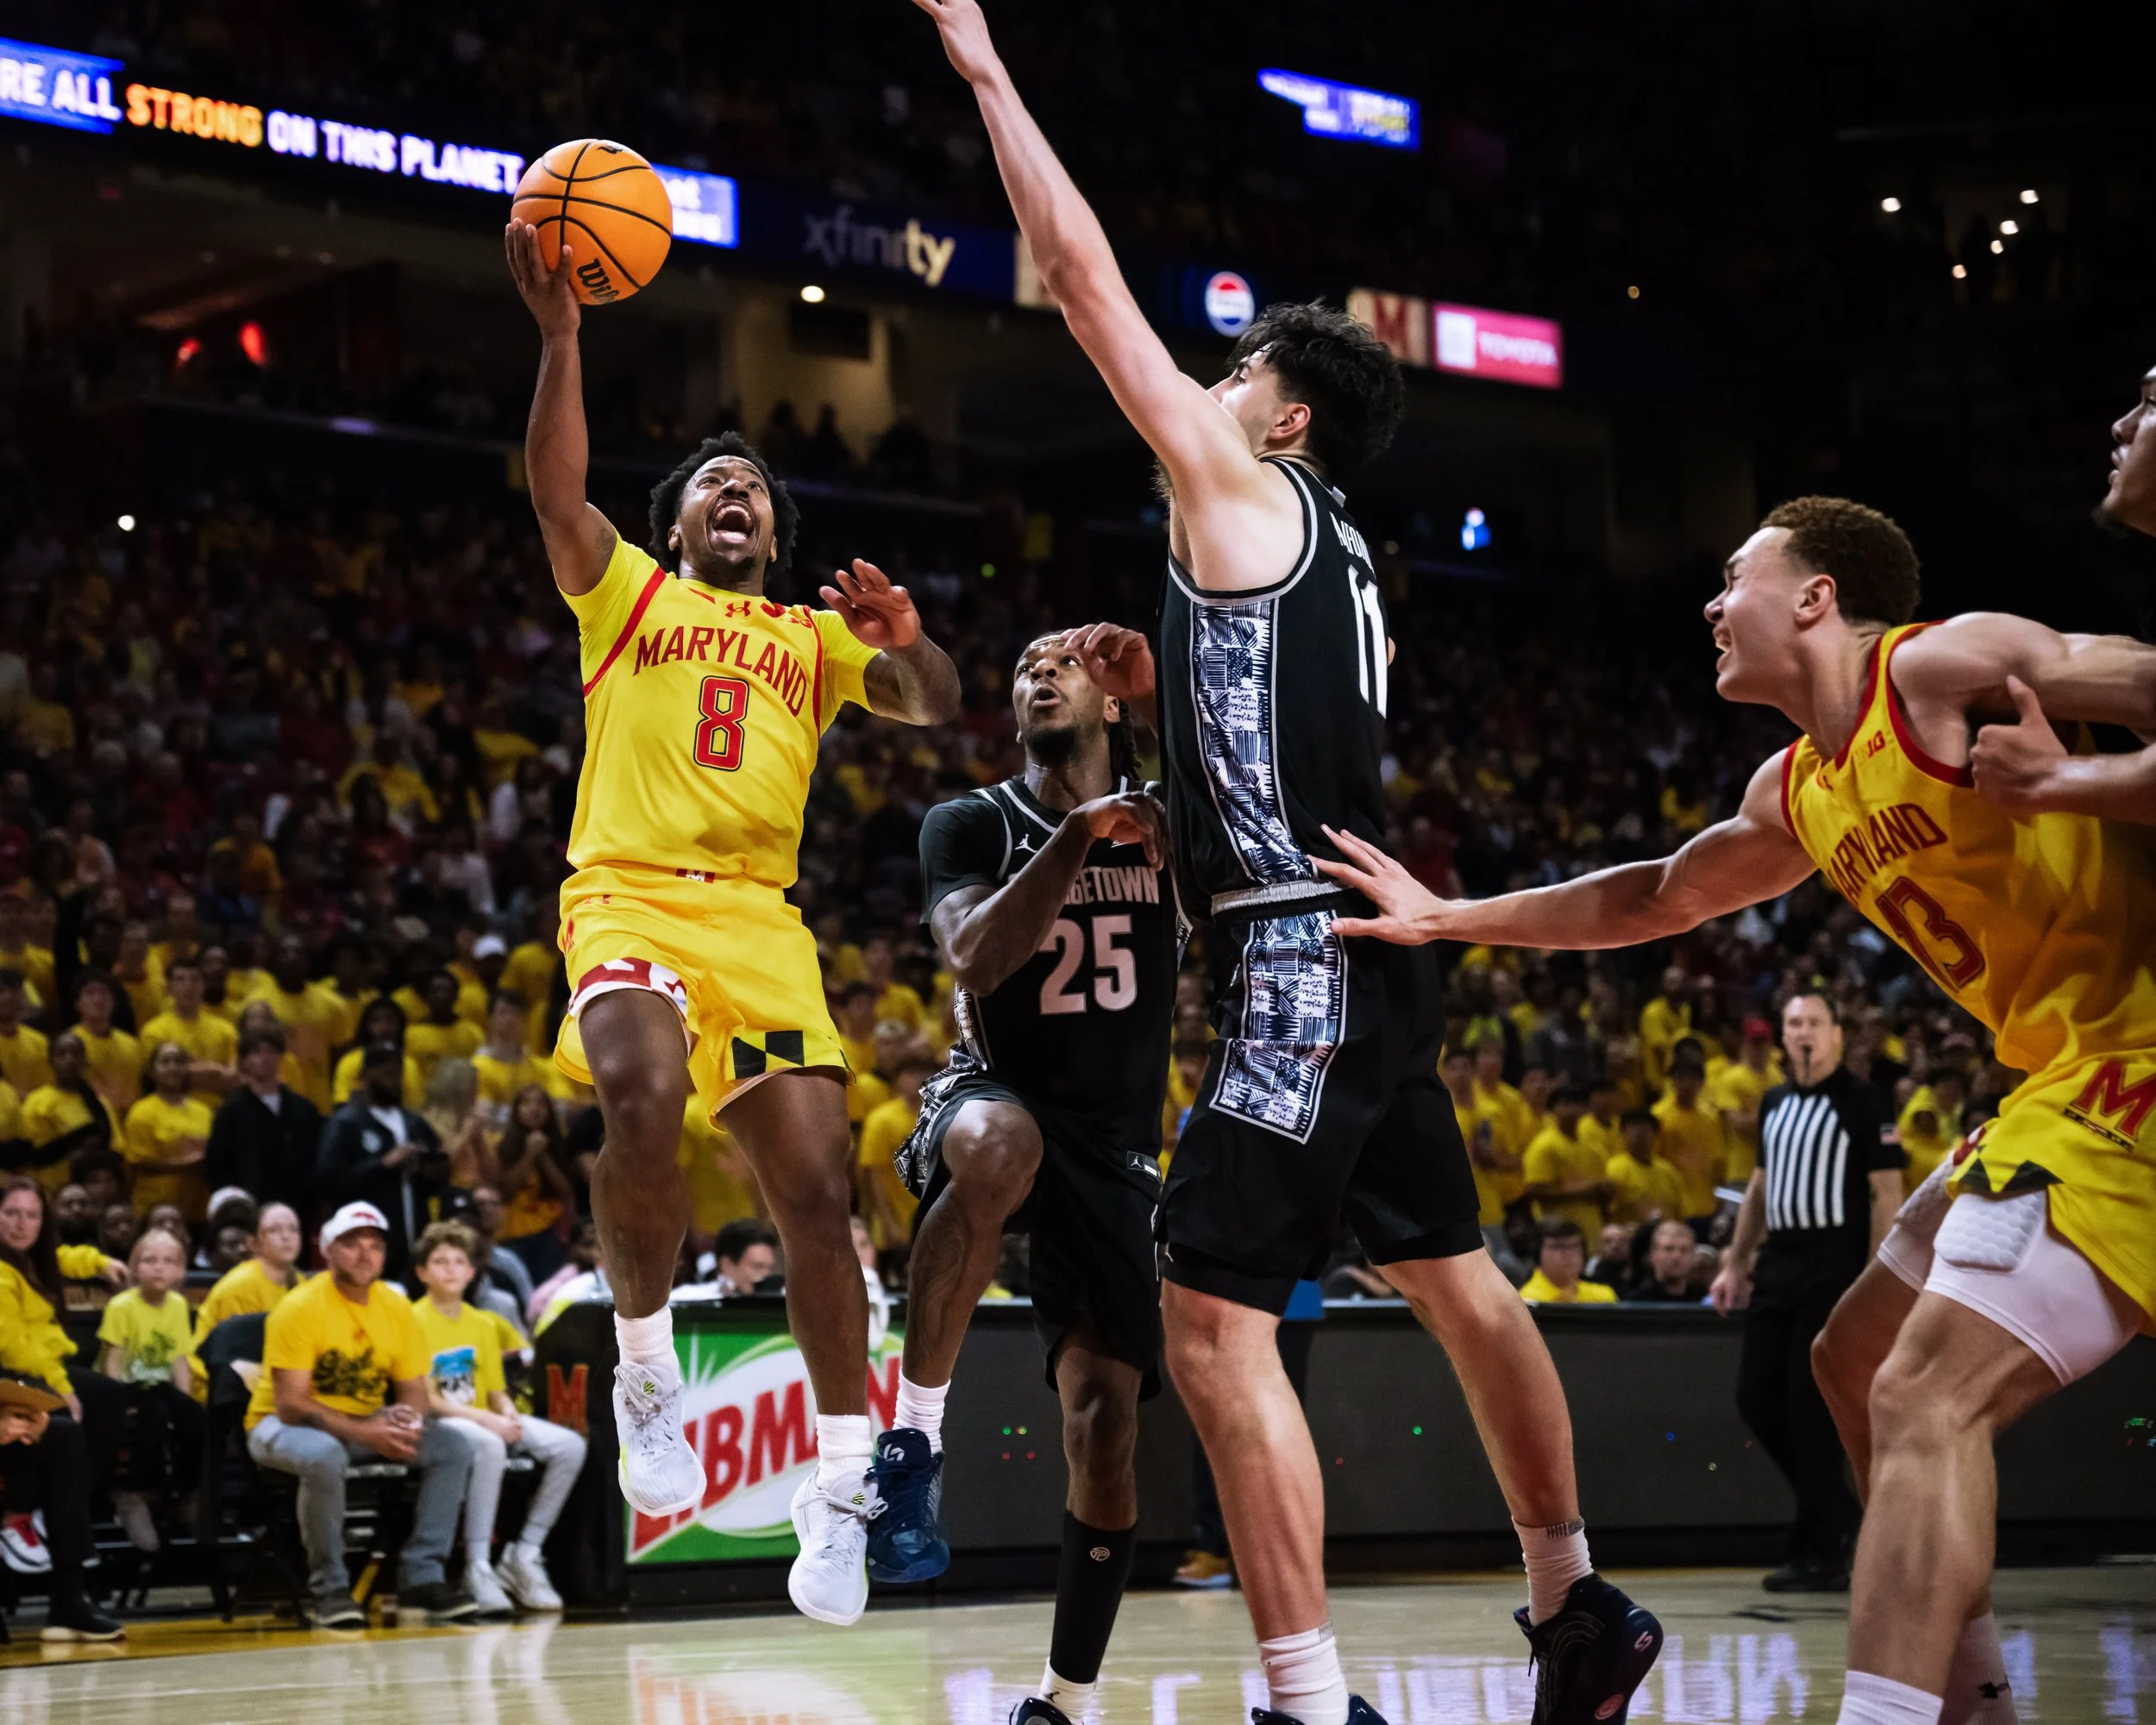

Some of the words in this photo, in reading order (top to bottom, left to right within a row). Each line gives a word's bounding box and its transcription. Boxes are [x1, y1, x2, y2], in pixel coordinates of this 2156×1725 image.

[52, 69, 122, 122] ALL
[126, 83, 263, 147] STRONG
[266, 110, 317, 158] ON
[319, 120, 398, 172] THIS
[401, 134, 524, 195] PLANET
[577, 258, 620, 303] Wil
[632, 625, 808, 718] MARYLAND
[1347, 563, 1388, 720] 11
[693, 674, 750, 772] 8
[1065, 865, 1159, 906] GETOWN
[1036, 913, 1138, 1016] 25
[1874, 875, 1986, 994] 13
[2069, 1059, 2156, 1143] M
[547, 1364, 590, 1438] M
